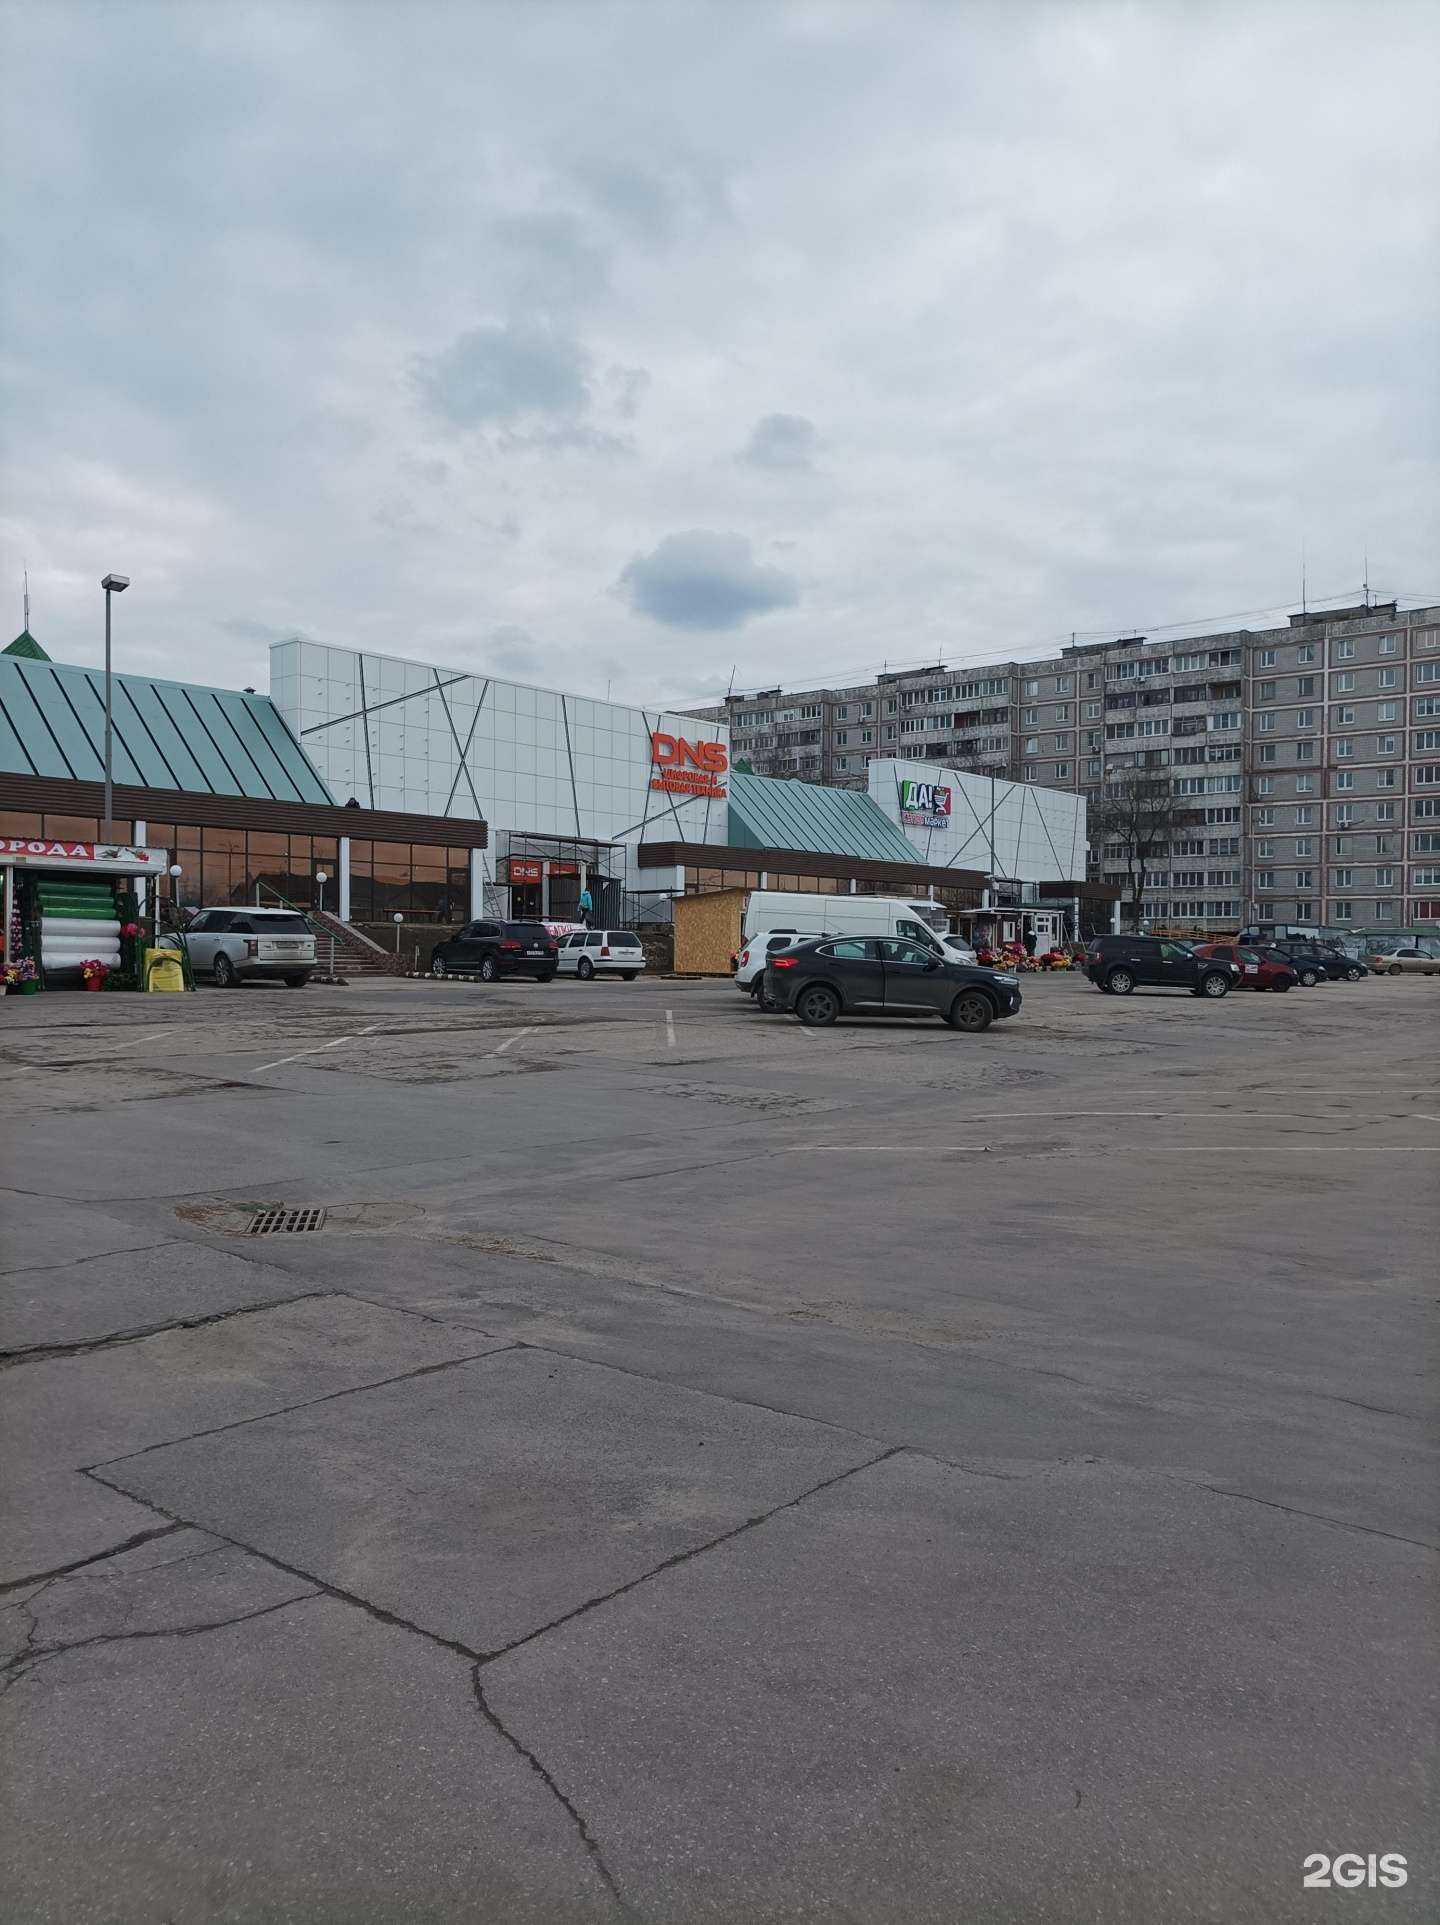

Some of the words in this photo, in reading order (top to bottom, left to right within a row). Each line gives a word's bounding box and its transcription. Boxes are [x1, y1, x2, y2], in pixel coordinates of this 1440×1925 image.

[651, 732, 729, 773] DNS
[905, 782, 933, 810] ДА!
[513, 866, 539, 877] DNS
